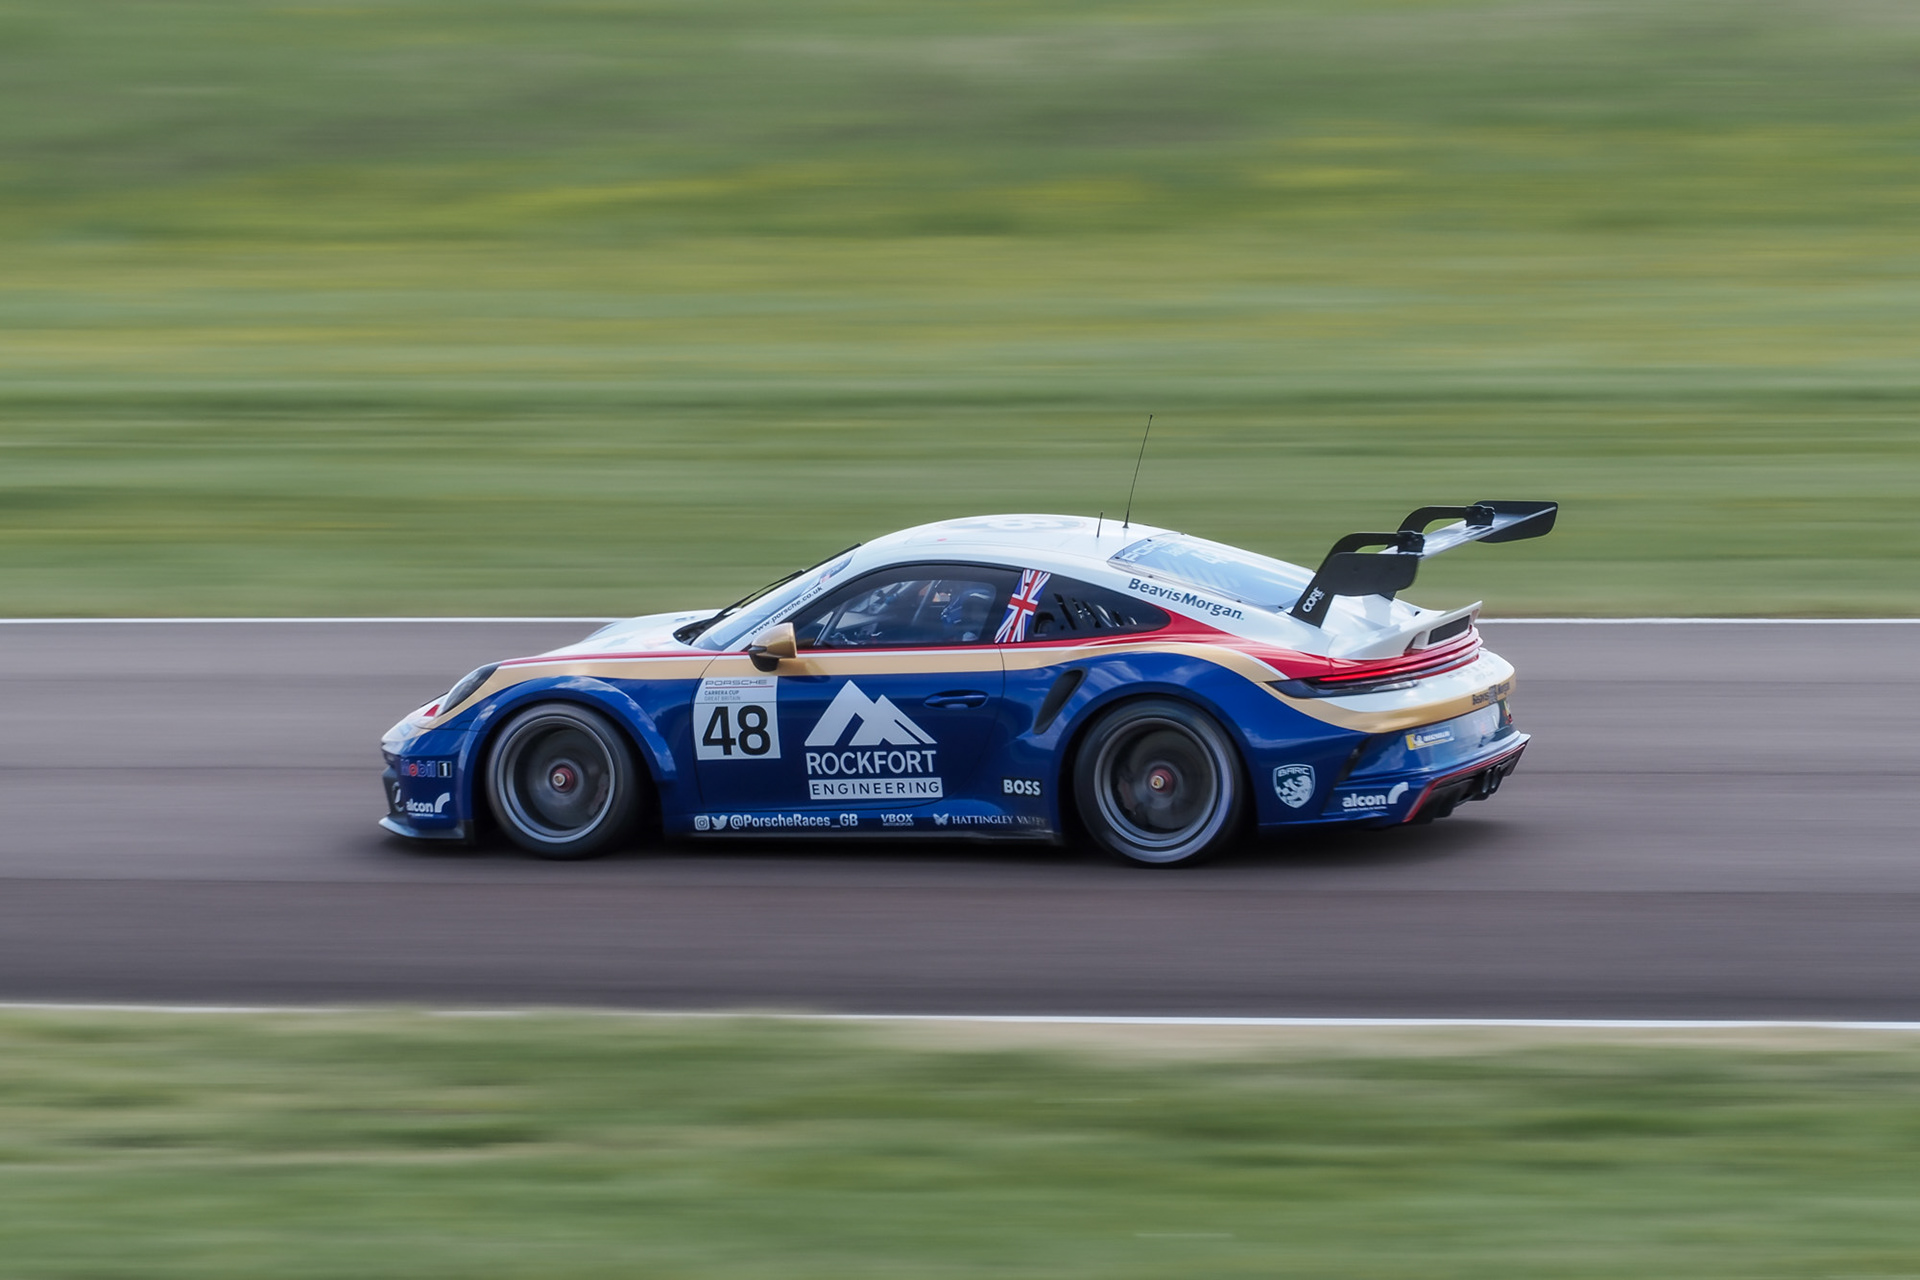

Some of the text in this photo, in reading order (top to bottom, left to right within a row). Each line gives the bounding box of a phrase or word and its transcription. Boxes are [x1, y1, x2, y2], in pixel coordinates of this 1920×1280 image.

[750, 586, 823, 636] www.porsche.co.uk
[702, 704, 771, 756] 48
[400, 758, 437, 777] Mobil
[805, 750, 937, 775] ROCKFORT
[1277, 766, 1311, 777] BARC
[811, 781, 940, 796] ENGINEERING
[1003, 779, 1041, 796] BOSS
[405, 798, 434, 812] alcon
[1342, 793, 1387, 808] alcon
[730, 813, 858, 830] @PorscheRaces_GB
[880, 813, 913, 822] VBOX
[952, 815, 1013, 825] HATTINGLEY
